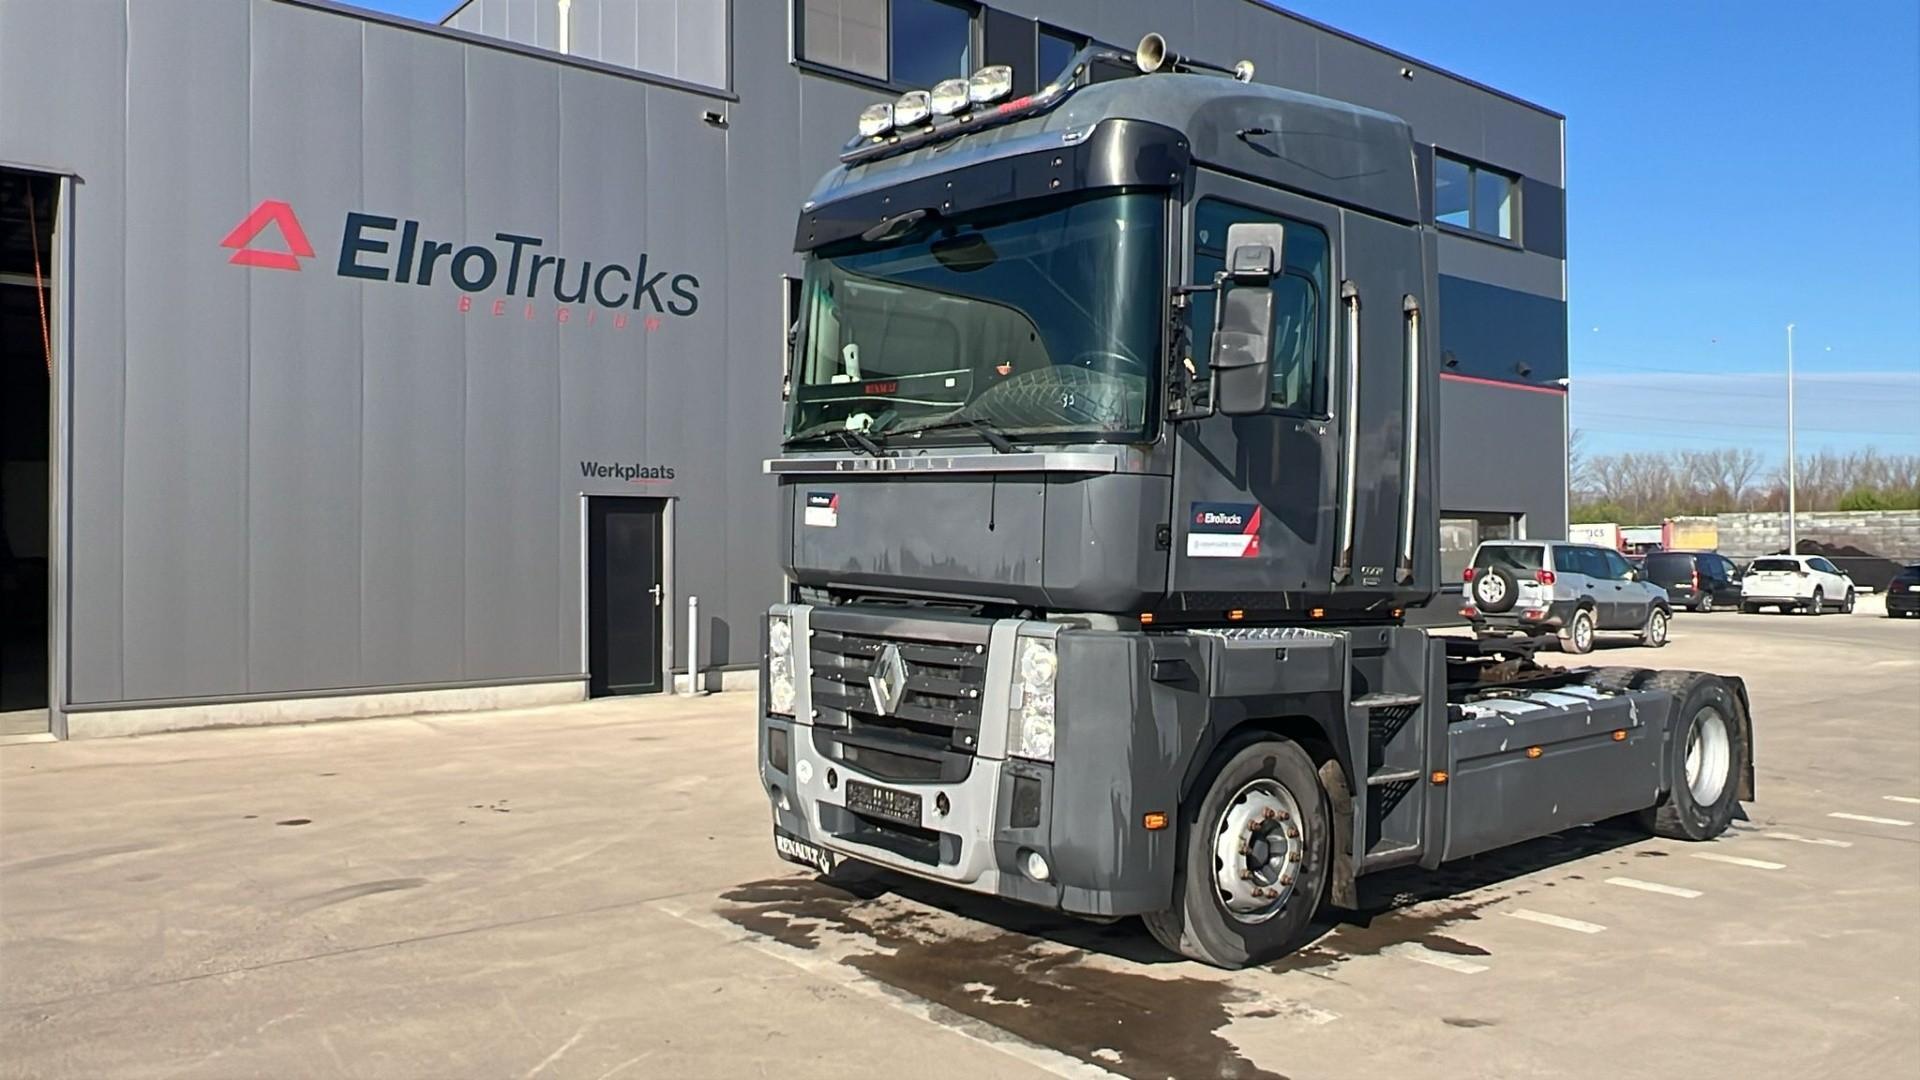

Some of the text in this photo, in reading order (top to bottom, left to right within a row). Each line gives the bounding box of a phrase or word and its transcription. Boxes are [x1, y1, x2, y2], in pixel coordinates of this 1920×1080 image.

[337, 211, 699, 317] ElroTrucks
[580, 461, 675, 481] Werkplaats
[776, 834, 819, 865] RENAULT
